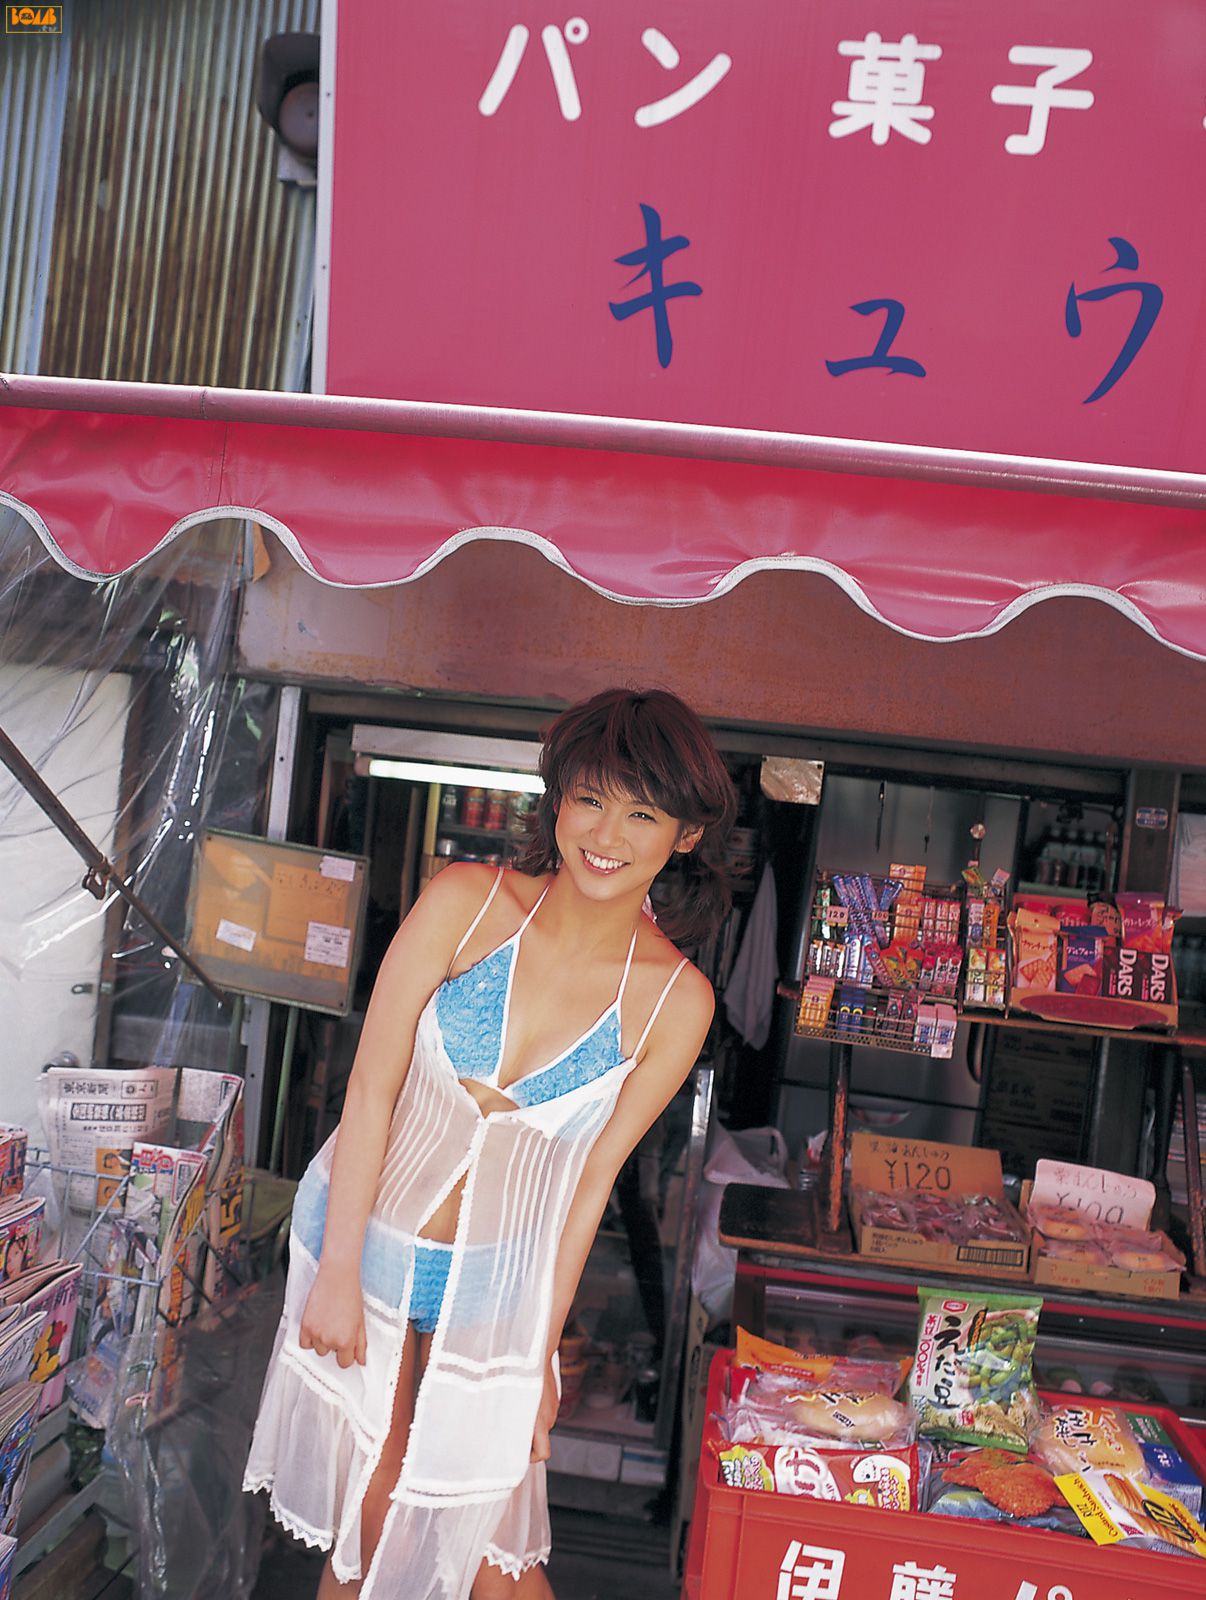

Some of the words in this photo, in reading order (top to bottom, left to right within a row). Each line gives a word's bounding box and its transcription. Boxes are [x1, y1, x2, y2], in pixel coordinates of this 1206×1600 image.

[478, 17, 732, 128] パン
[828, 31, 1095, 155] 菓子
[1117, 948, 1138, 997] DARS
[1150, 954, 1170, 1004] DARS
[884, 1159, 951, 1191] ¥120
